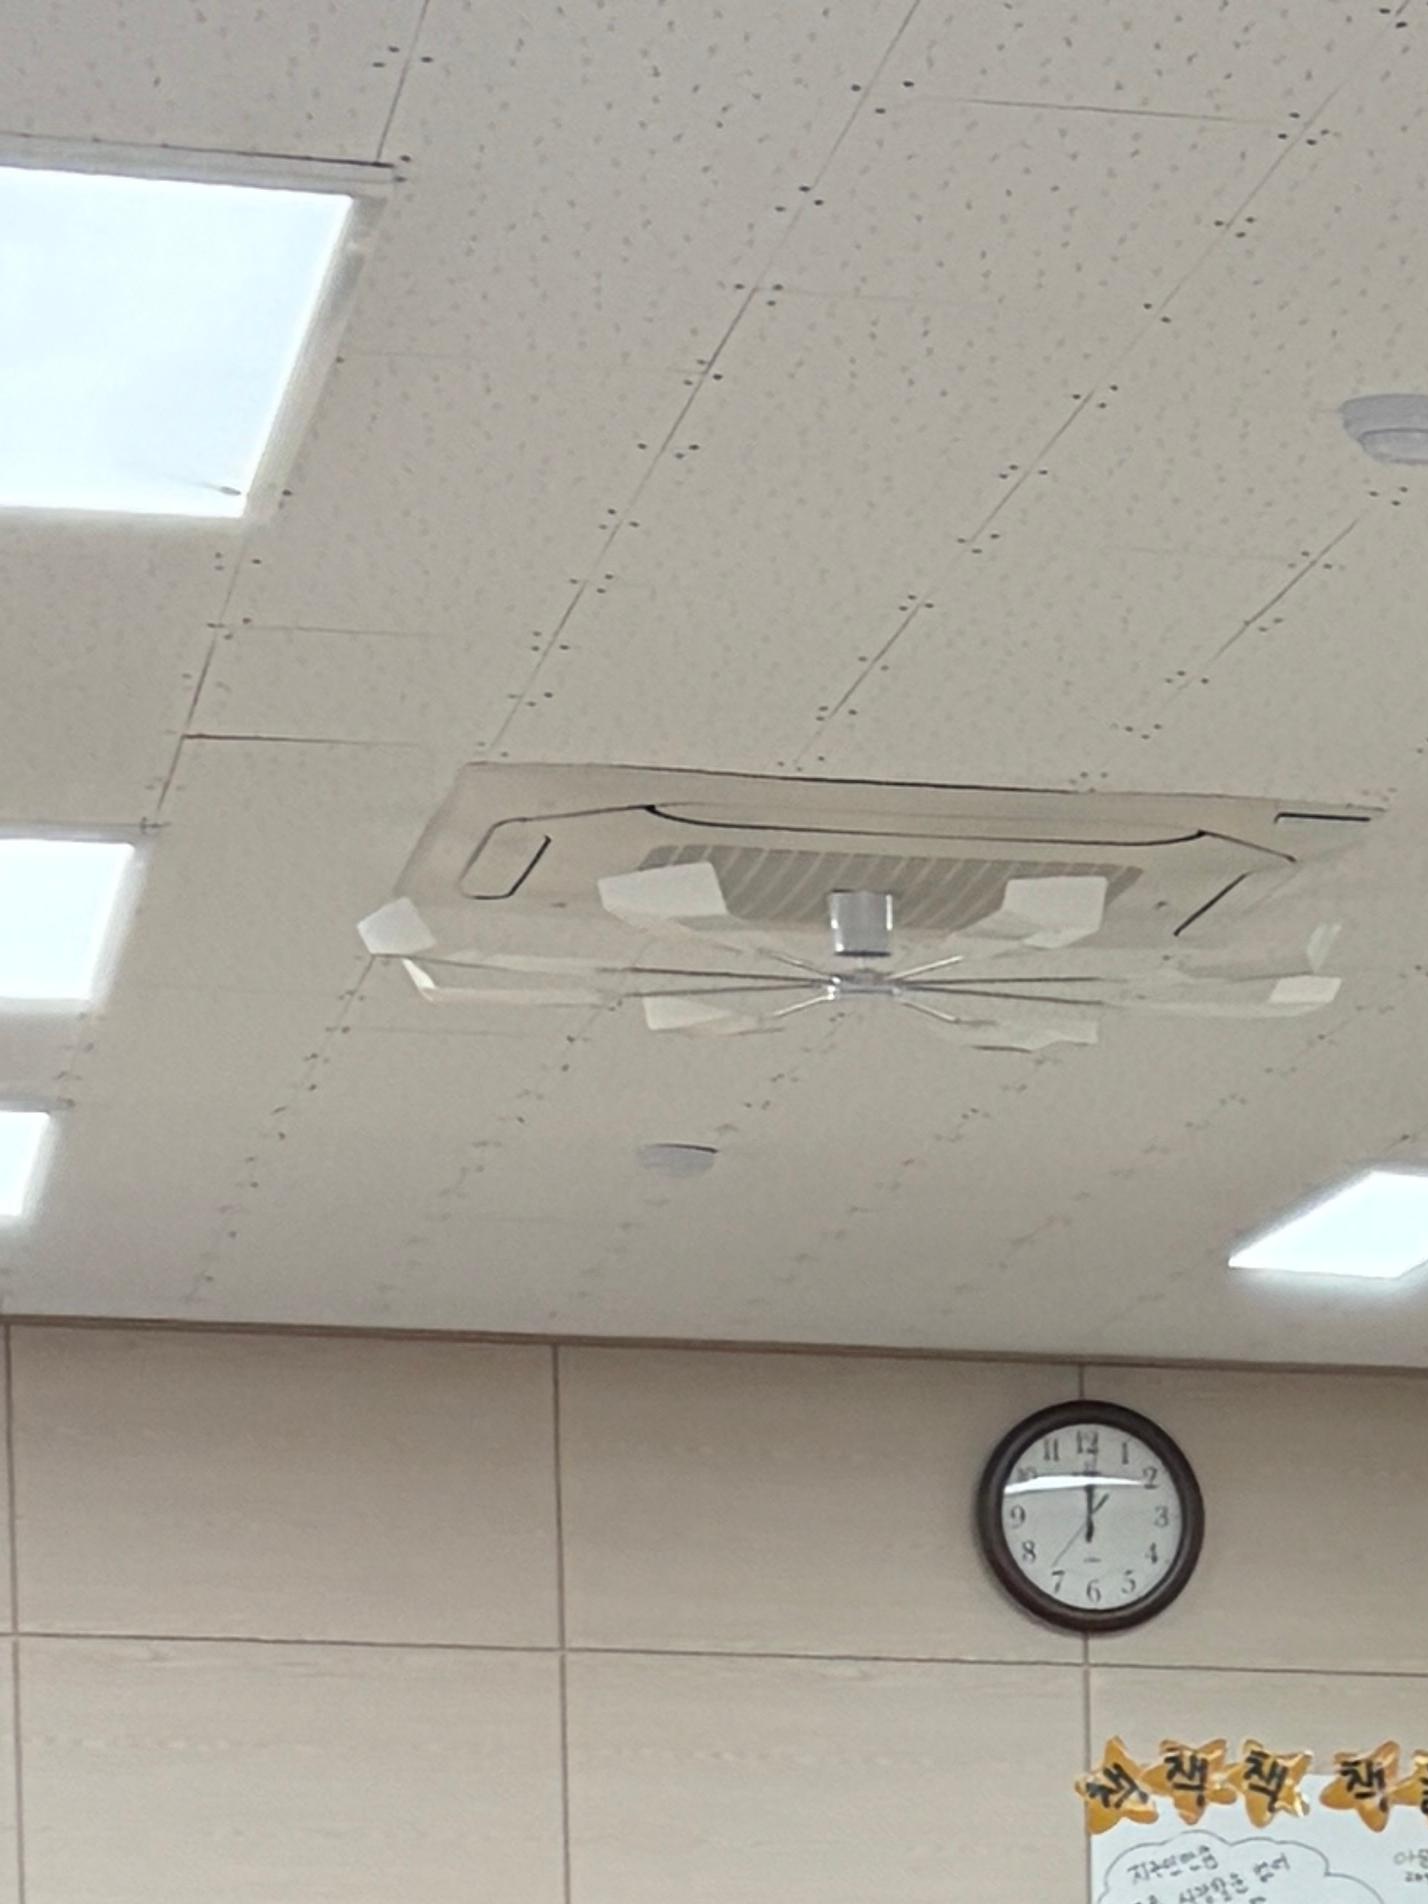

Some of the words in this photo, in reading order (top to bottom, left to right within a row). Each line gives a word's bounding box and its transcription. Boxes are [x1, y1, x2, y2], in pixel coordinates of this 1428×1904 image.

[1043, 1438, 1060, 1461] 11
[1075, 1429, 1099, 1455] 12
[1120, 1442, 1130, 1464] 1
[1142, 1466, 1158, 1489] 2
[1009, 1506, 1026, 1526] 9
[1154, 1507, 1169, 1528] 3
[1021, 1540, 1037, 1564] 8
[1145, 1543, 1159, 1565] 4
[1051, 1569, 1066, 1594] 7
[1086, 1578, 1101, 1603] 6
[1121, 1570, 1137, 1594] 5
